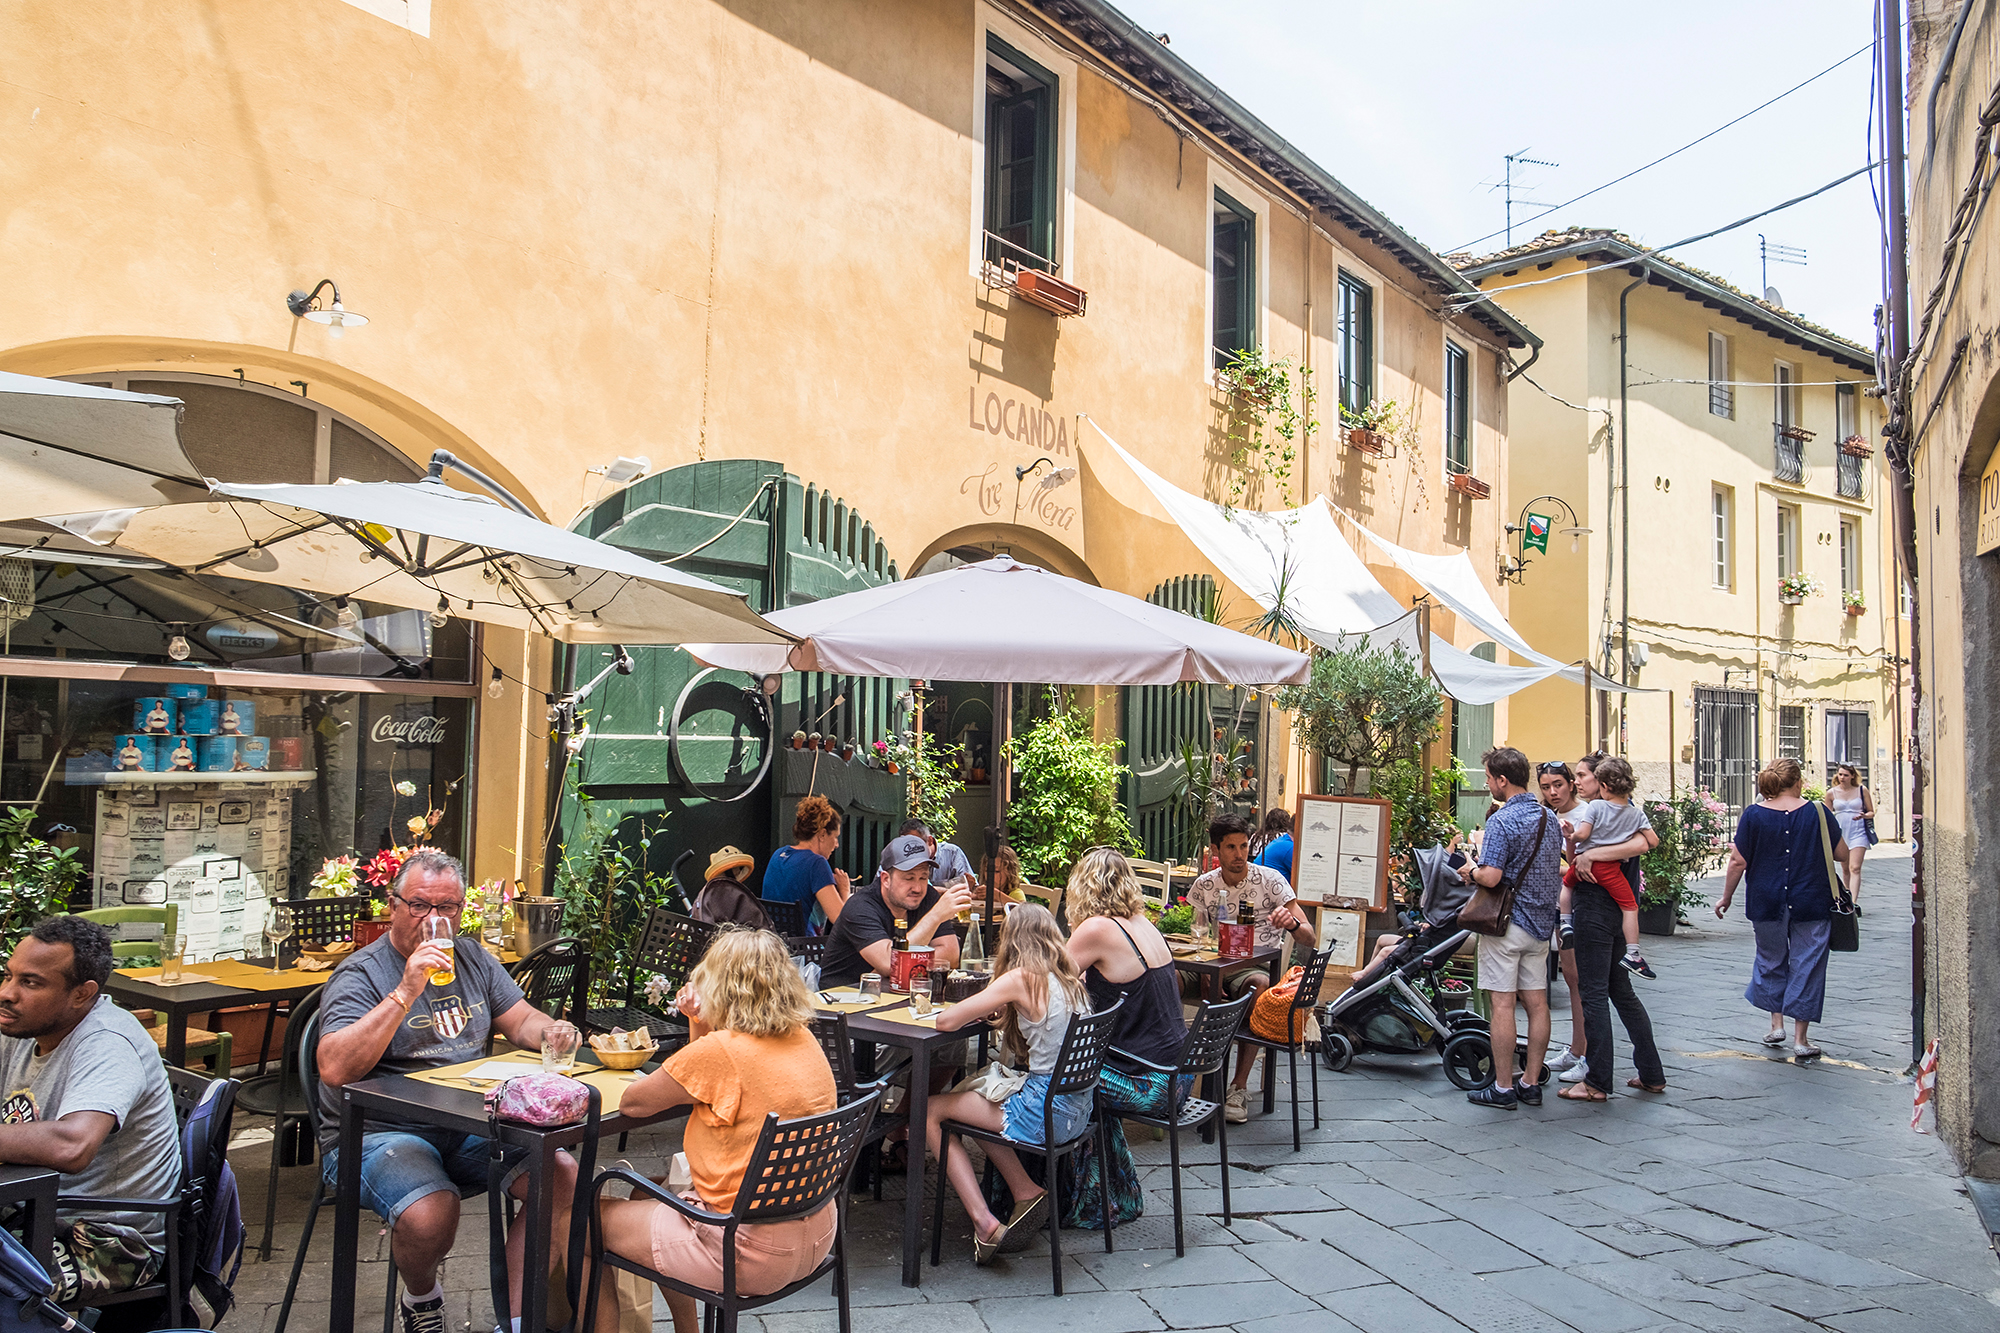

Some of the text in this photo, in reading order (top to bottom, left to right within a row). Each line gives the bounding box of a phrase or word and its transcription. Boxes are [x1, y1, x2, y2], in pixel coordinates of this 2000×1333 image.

[969, 386, 1070, 458] LOCANDA
[960, 461, 1002, 517] Tre
[1982, 469, 2000, 516] TO
[221, 637, 264, 648] BECK'S
[371, 714, 451, 744] Coca-Cola
[53, 1236, 79, 1302] QUAD
